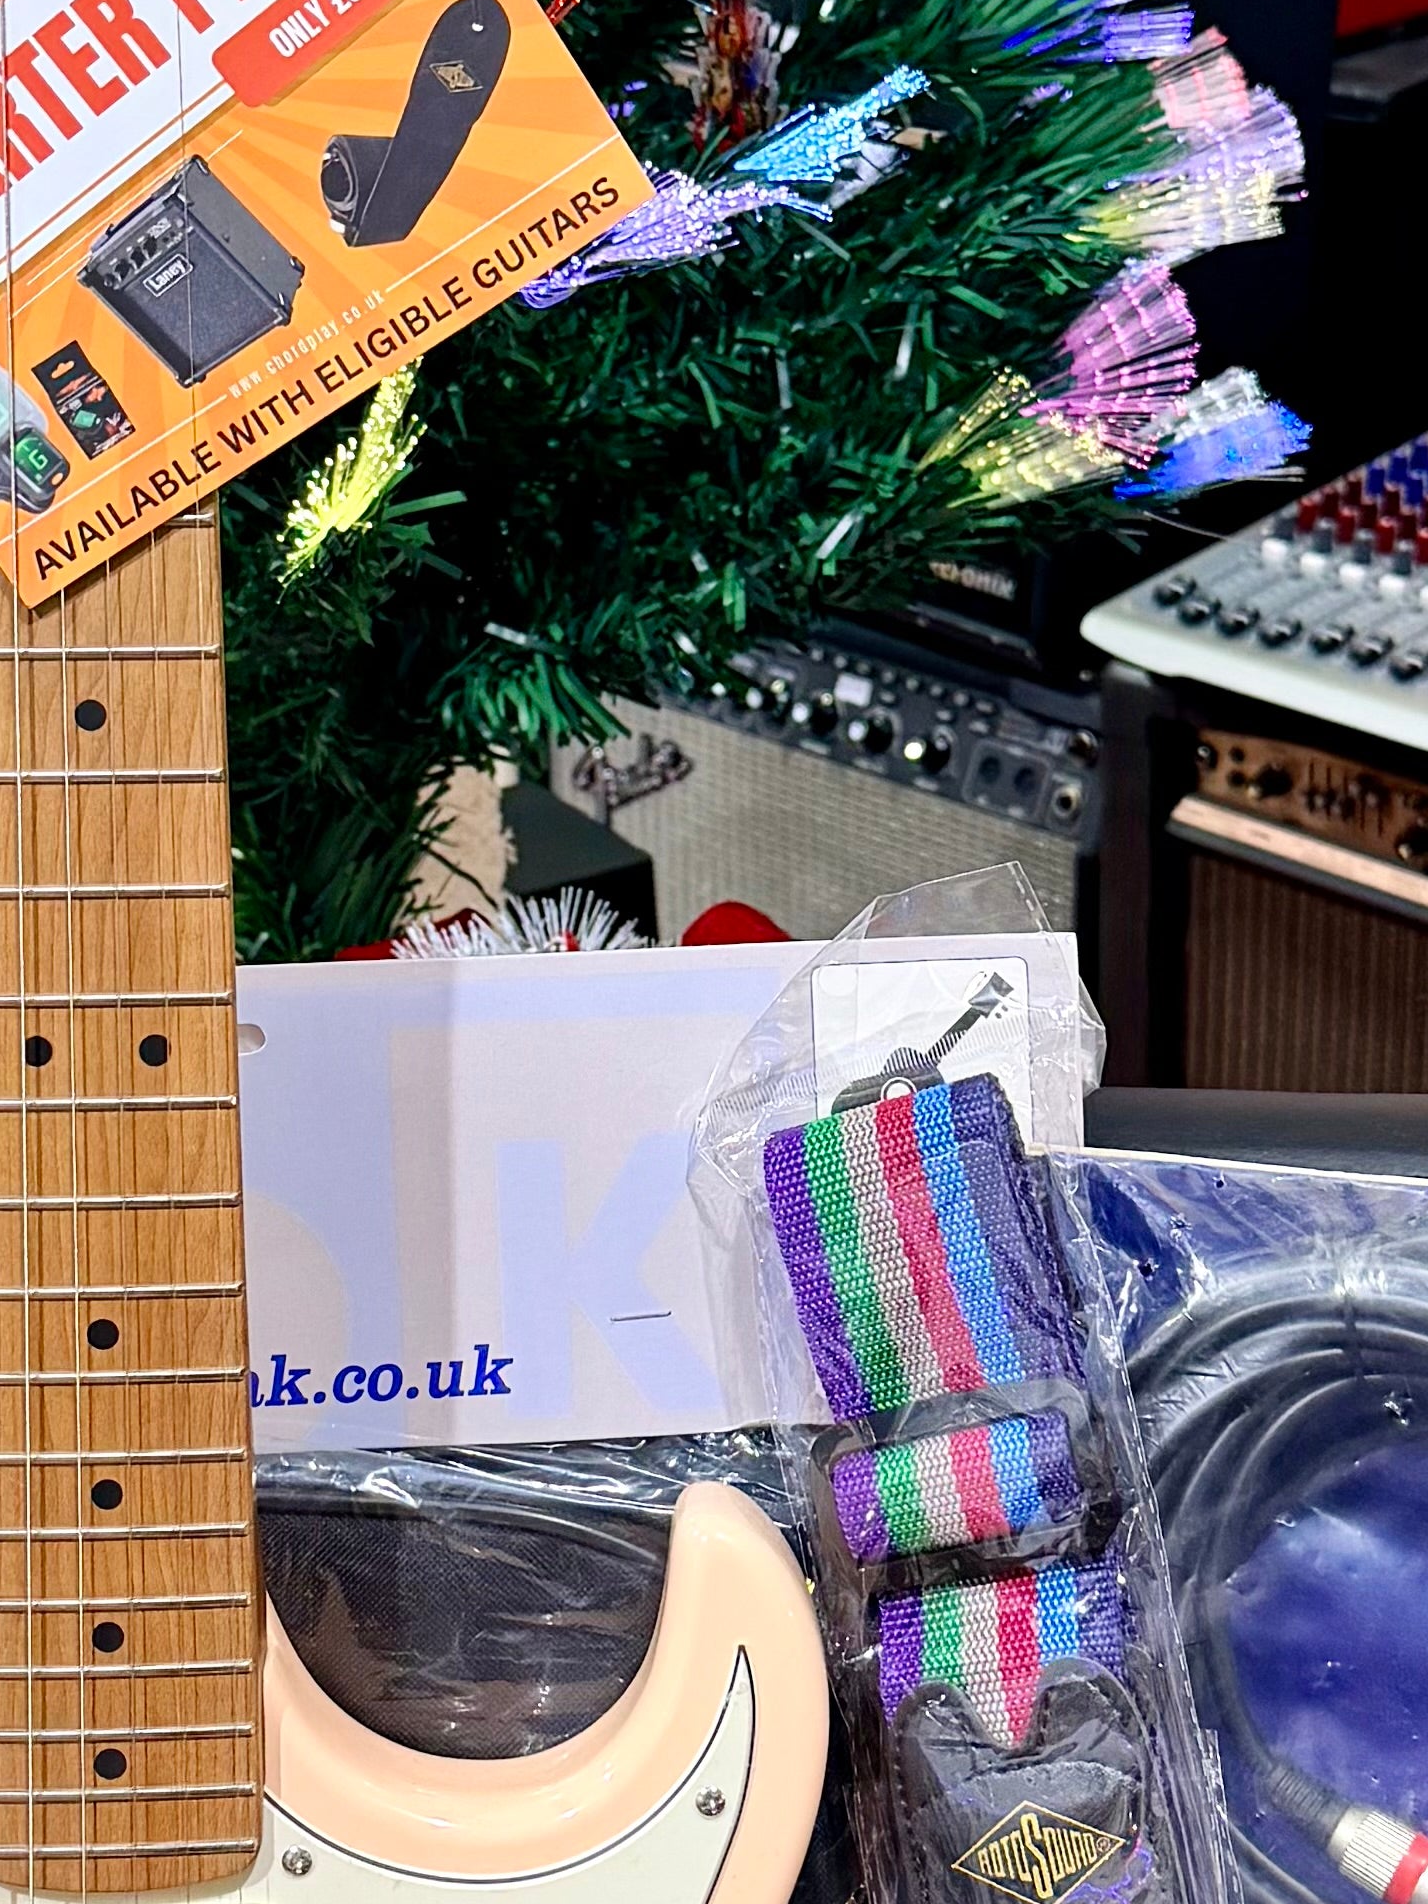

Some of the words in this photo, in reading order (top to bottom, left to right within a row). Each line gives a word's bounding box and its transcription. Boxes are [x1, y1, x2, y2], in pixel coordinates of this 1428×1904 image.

[33, 441, 222, 580] AVAILABLE
[217, 378, 316, 457] WITH
[313, 275, 472, 394] ELIGIBLE
[470, 176, 621, 290] GUITARS
[227, 289, 386, 400] www.chordplay.co.uk
[977, 1811, 1098, 1900] ROTOSOUND
